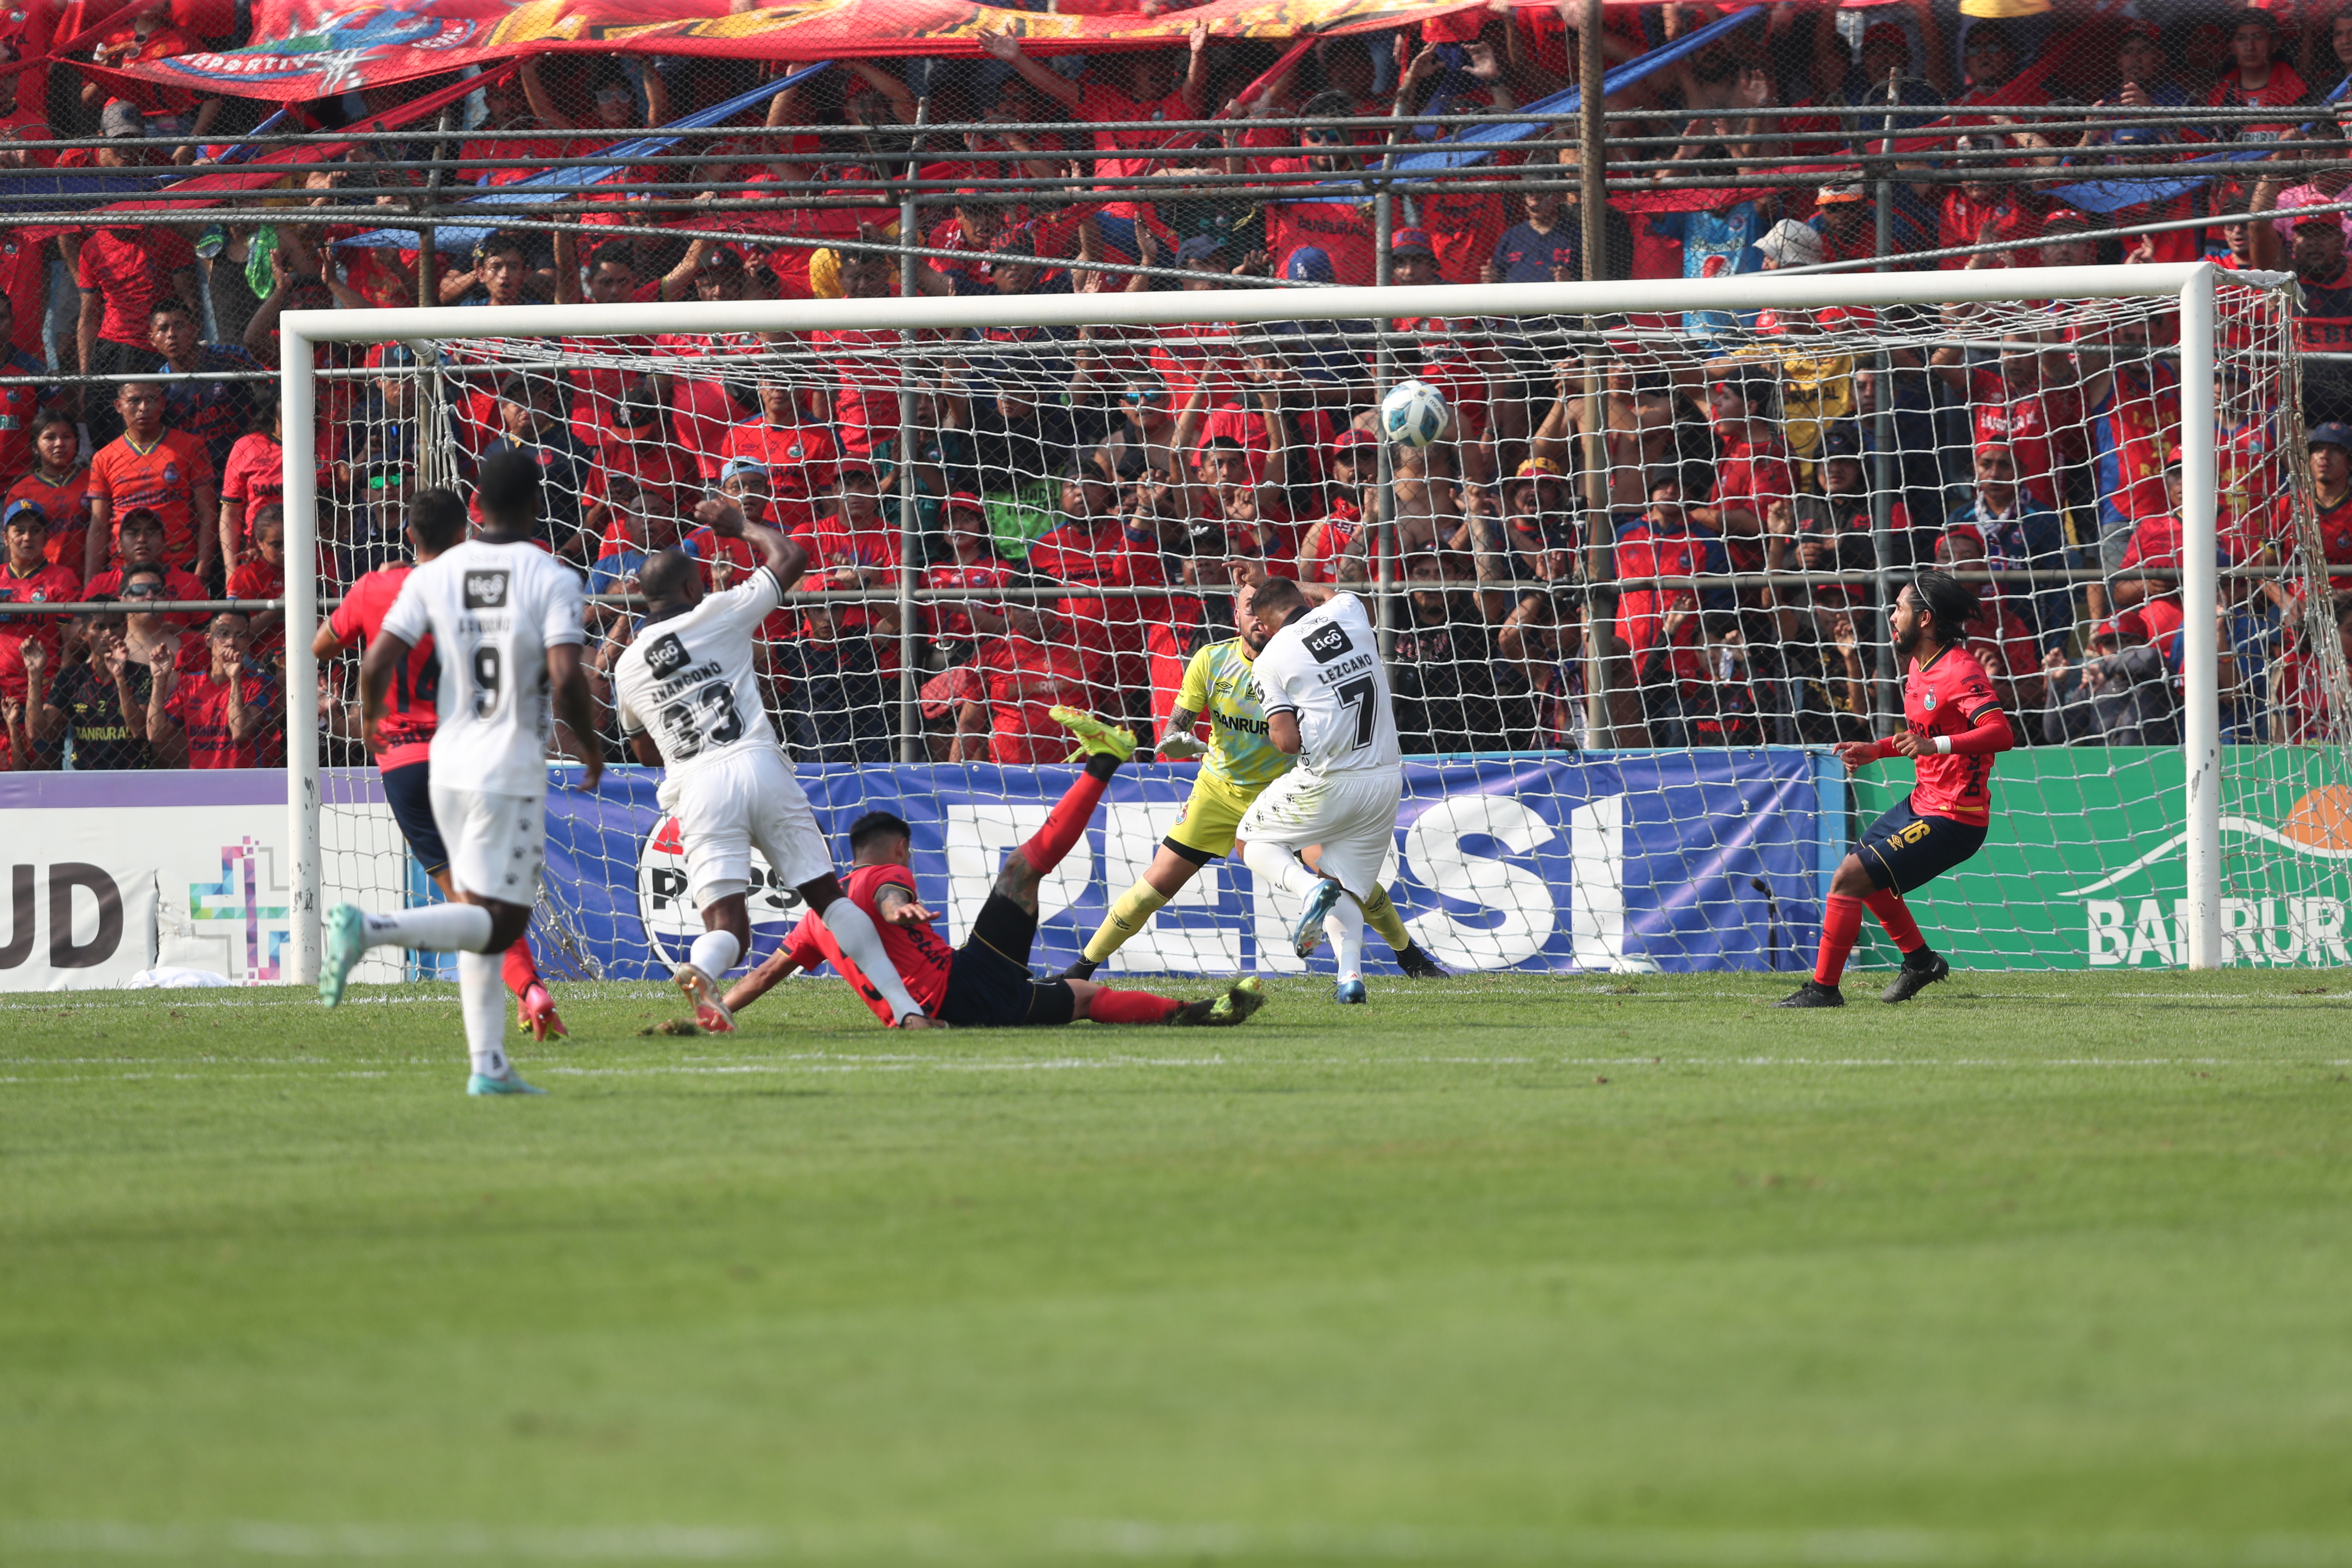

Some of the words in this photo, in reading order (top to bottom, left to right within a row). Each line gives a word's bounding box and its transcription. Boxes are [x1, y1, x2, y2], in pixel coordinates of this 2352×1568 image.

[1429, 399, 1446, 422] molten
[1294, 615, 1329, 635] sears
[649, 640, 679, 667] tigo
[1311, 630, 1342, 651] tigo
[472, 640, 502, 723] 9
[652, 658, 723, 704] ANANGONÓ
[1317, 653, 1373, 686] LEZCANO
[659, 680, 745, 763] 33
[1332, 671, 1378, 751] 7
[76, 726, 131, 740] BANRURAL
[1886, 838, 1898, 851] umbro
[1898, 820, 1930, 844] 16
[652, 867, 805, 910] PPS
